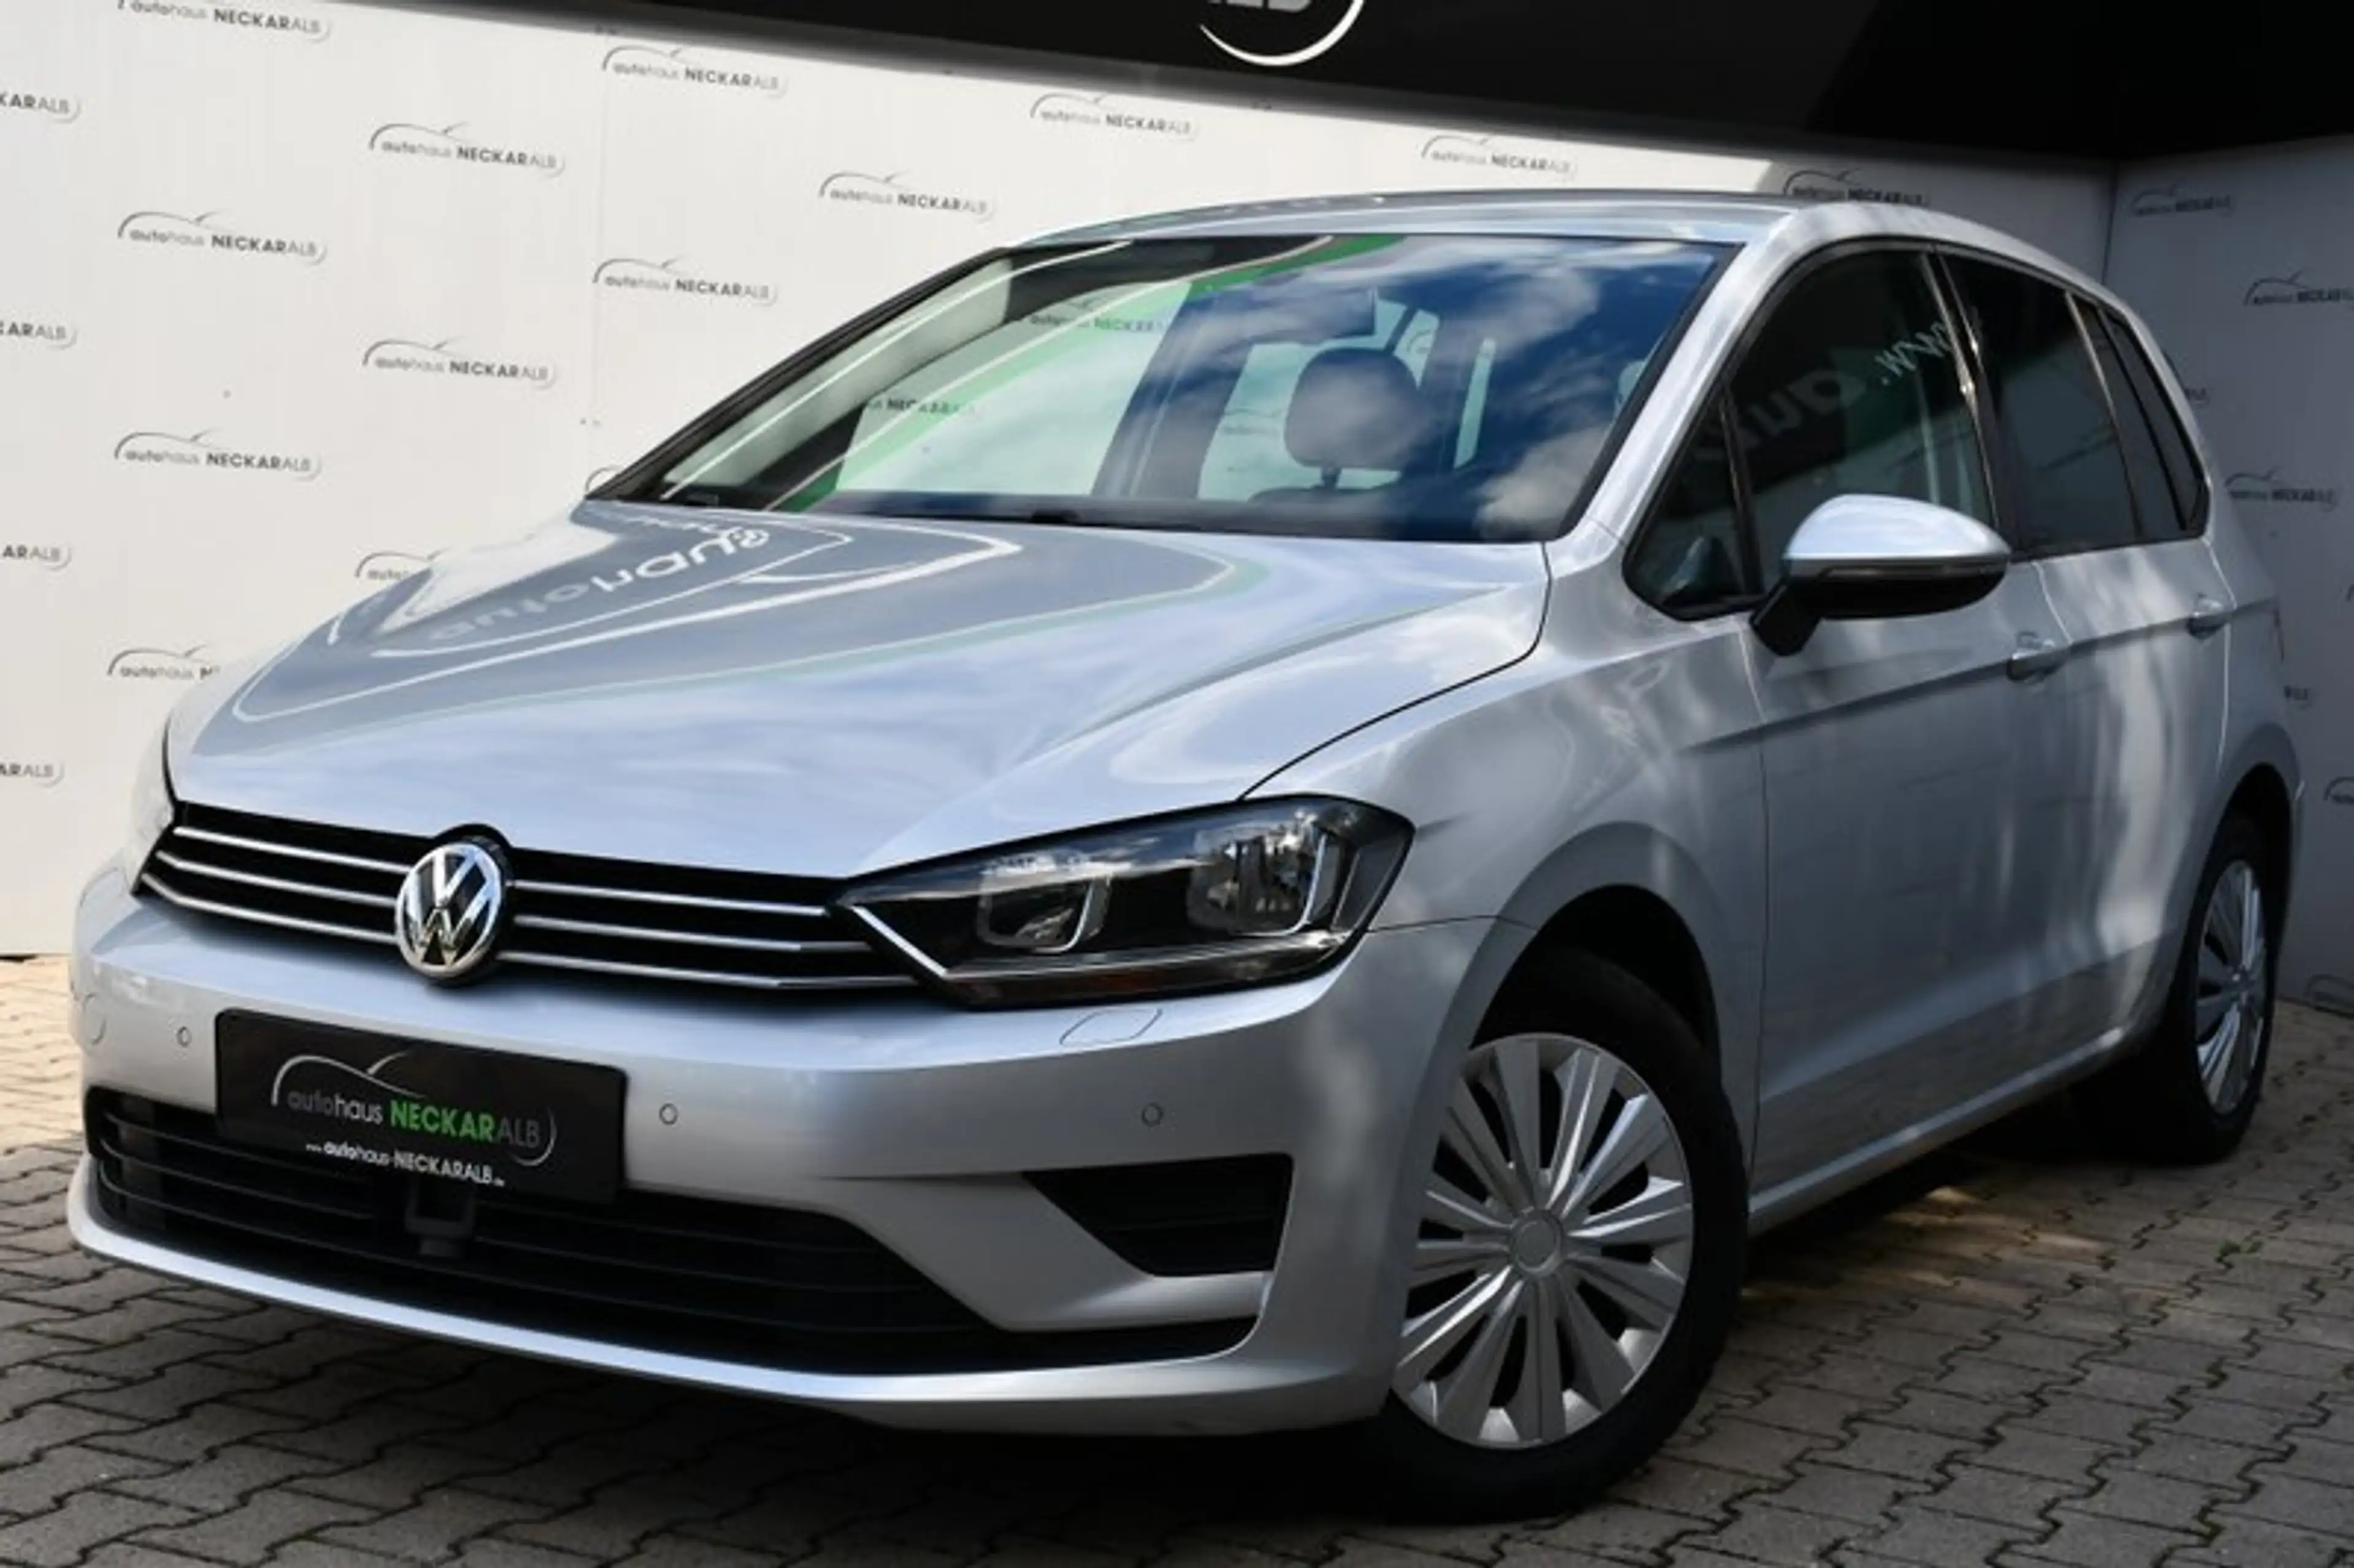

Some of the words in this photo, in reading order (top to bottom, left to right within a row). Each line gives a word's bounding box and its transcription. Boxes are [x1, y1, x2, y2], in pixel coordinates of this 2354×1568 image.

[457, 146, 557, 169] NECKARALB
[211, 235, 317, 257] NECKARALB
[205, 452, 310, 472] NECKARALB
[287, 1089, 383, 1125] autohaus
[390, 1100, 541, 1149] NECKARALB
